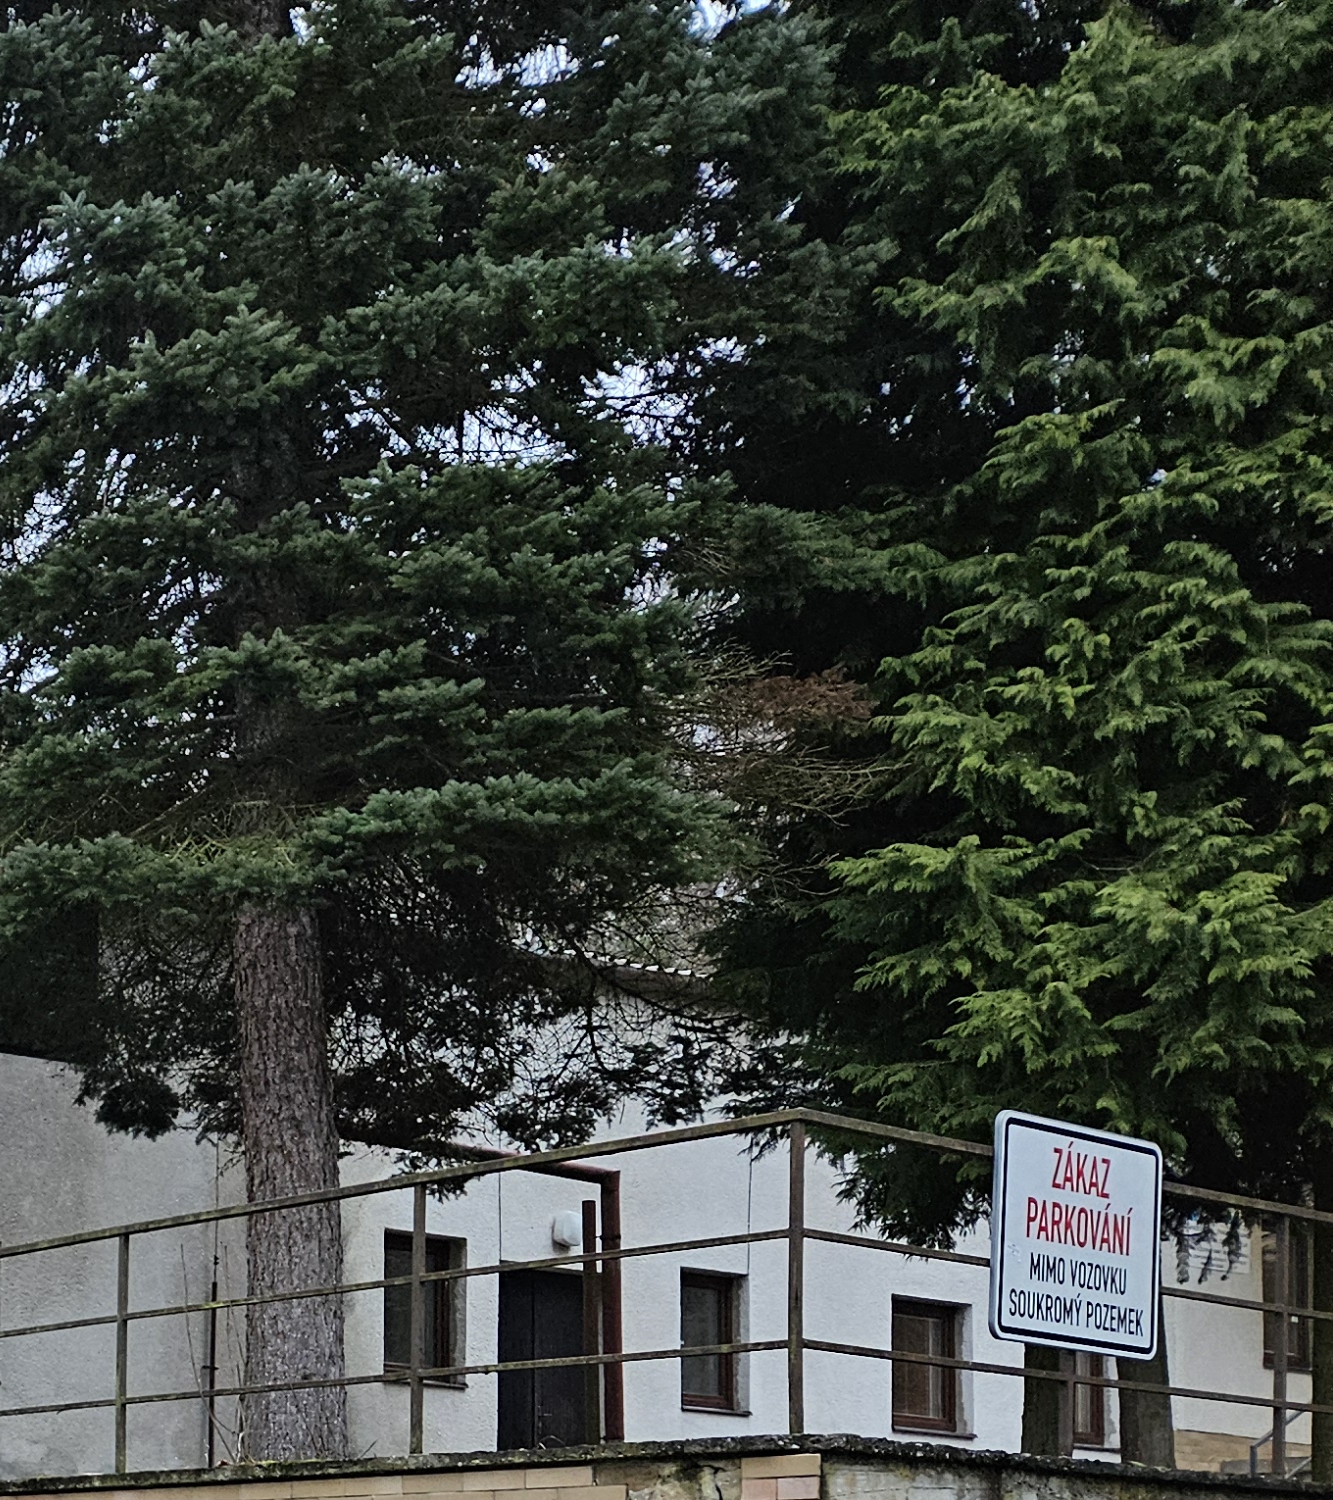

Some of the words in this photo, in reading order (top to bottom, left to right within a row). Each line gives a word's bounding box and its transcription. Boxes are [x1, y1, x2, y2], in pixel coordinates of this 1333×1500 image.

[1051, 1141, 1111, 1199] ZÁKAZ
[1026, 1196, 1133, 1256] PARKOVÁNÍ
[1030, 1252, 1065, 1285] MIMO
[1070, 1259, 1127, 1295] VOZOVKU
[1009, 1288, 1082, 1327] SOUKROMÝ
[1086, 1301, 1143, 1337] POZEMEK
